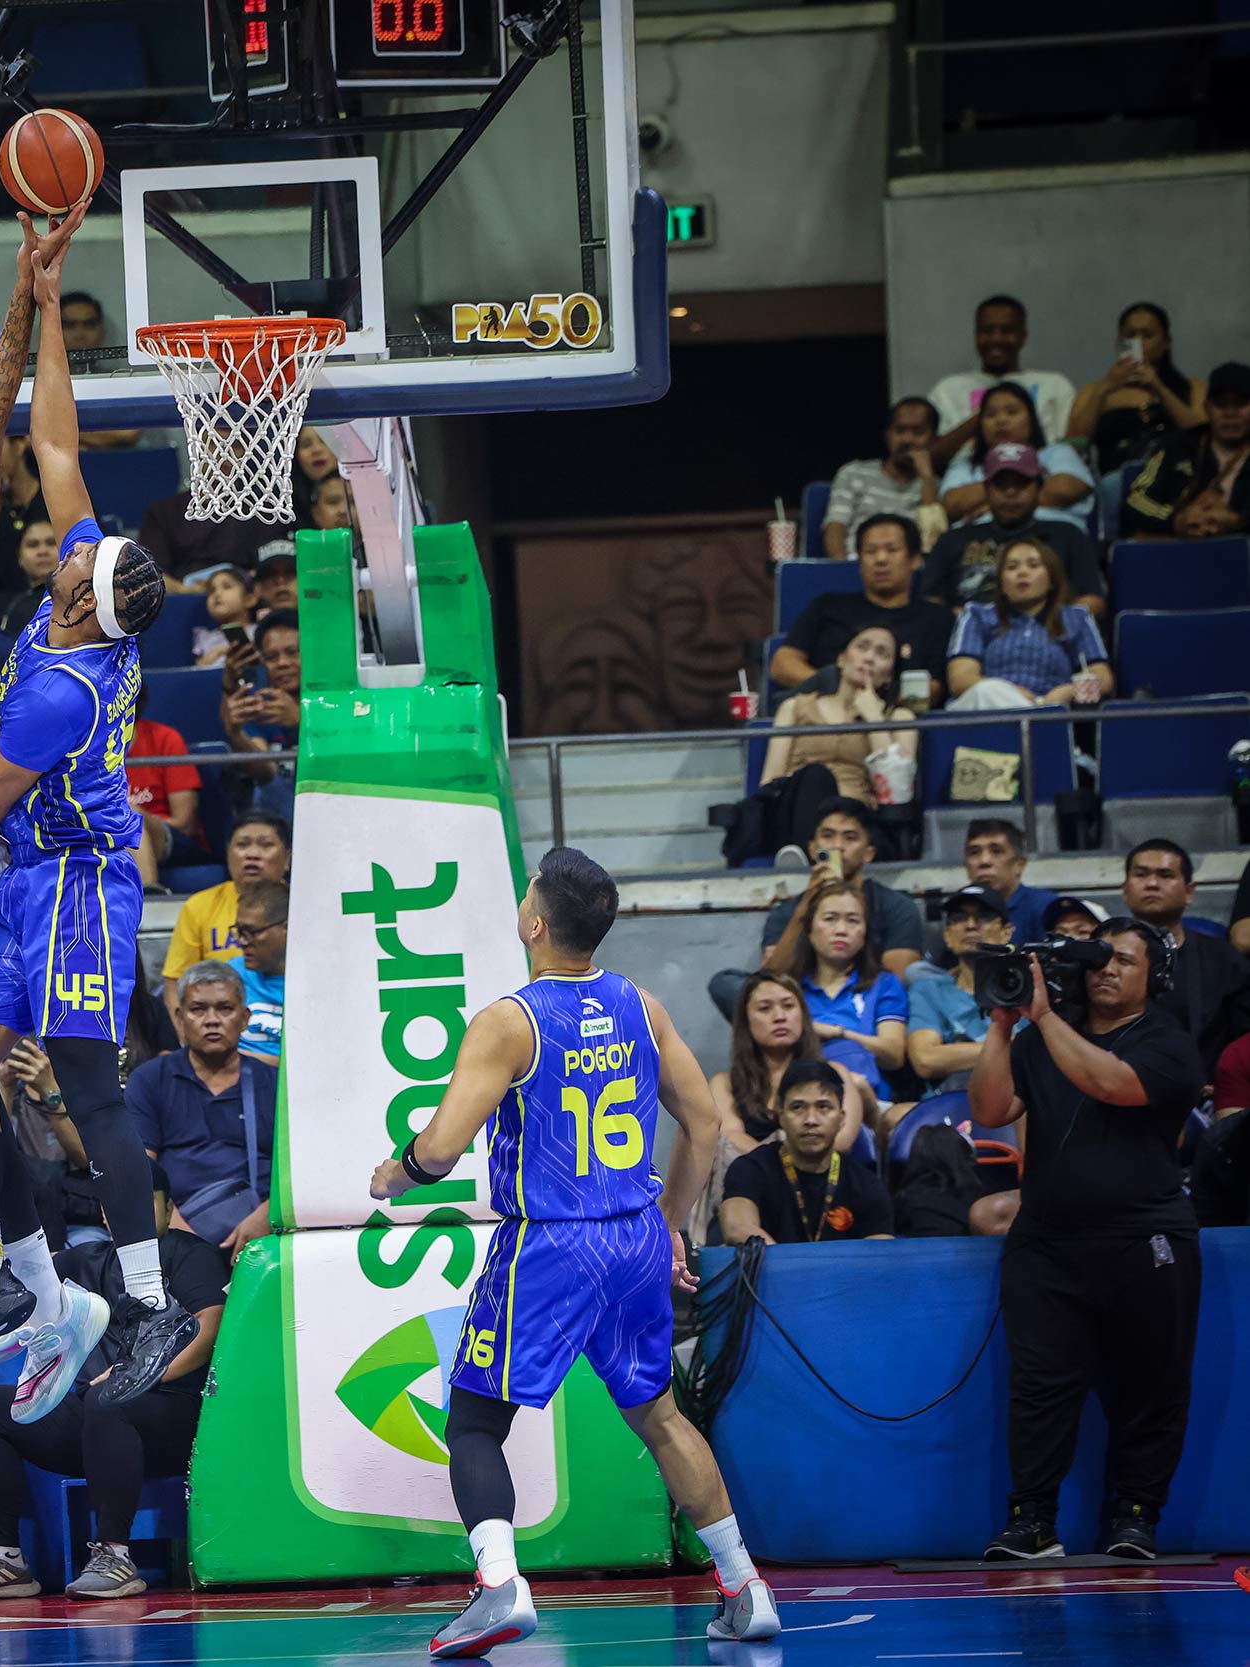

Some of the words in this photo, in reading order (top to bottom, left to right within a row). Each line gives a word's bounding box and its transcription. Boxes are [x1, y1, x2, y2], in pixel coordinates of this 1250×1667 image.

[373, 0, 445, 41] 0.0
[55, 973, 106, 1012] 45
[564, 1040, 635, 1077] POGOY
[561, 1076, 644, 1177] 16
[464, 1324, 496, 1368] 16
